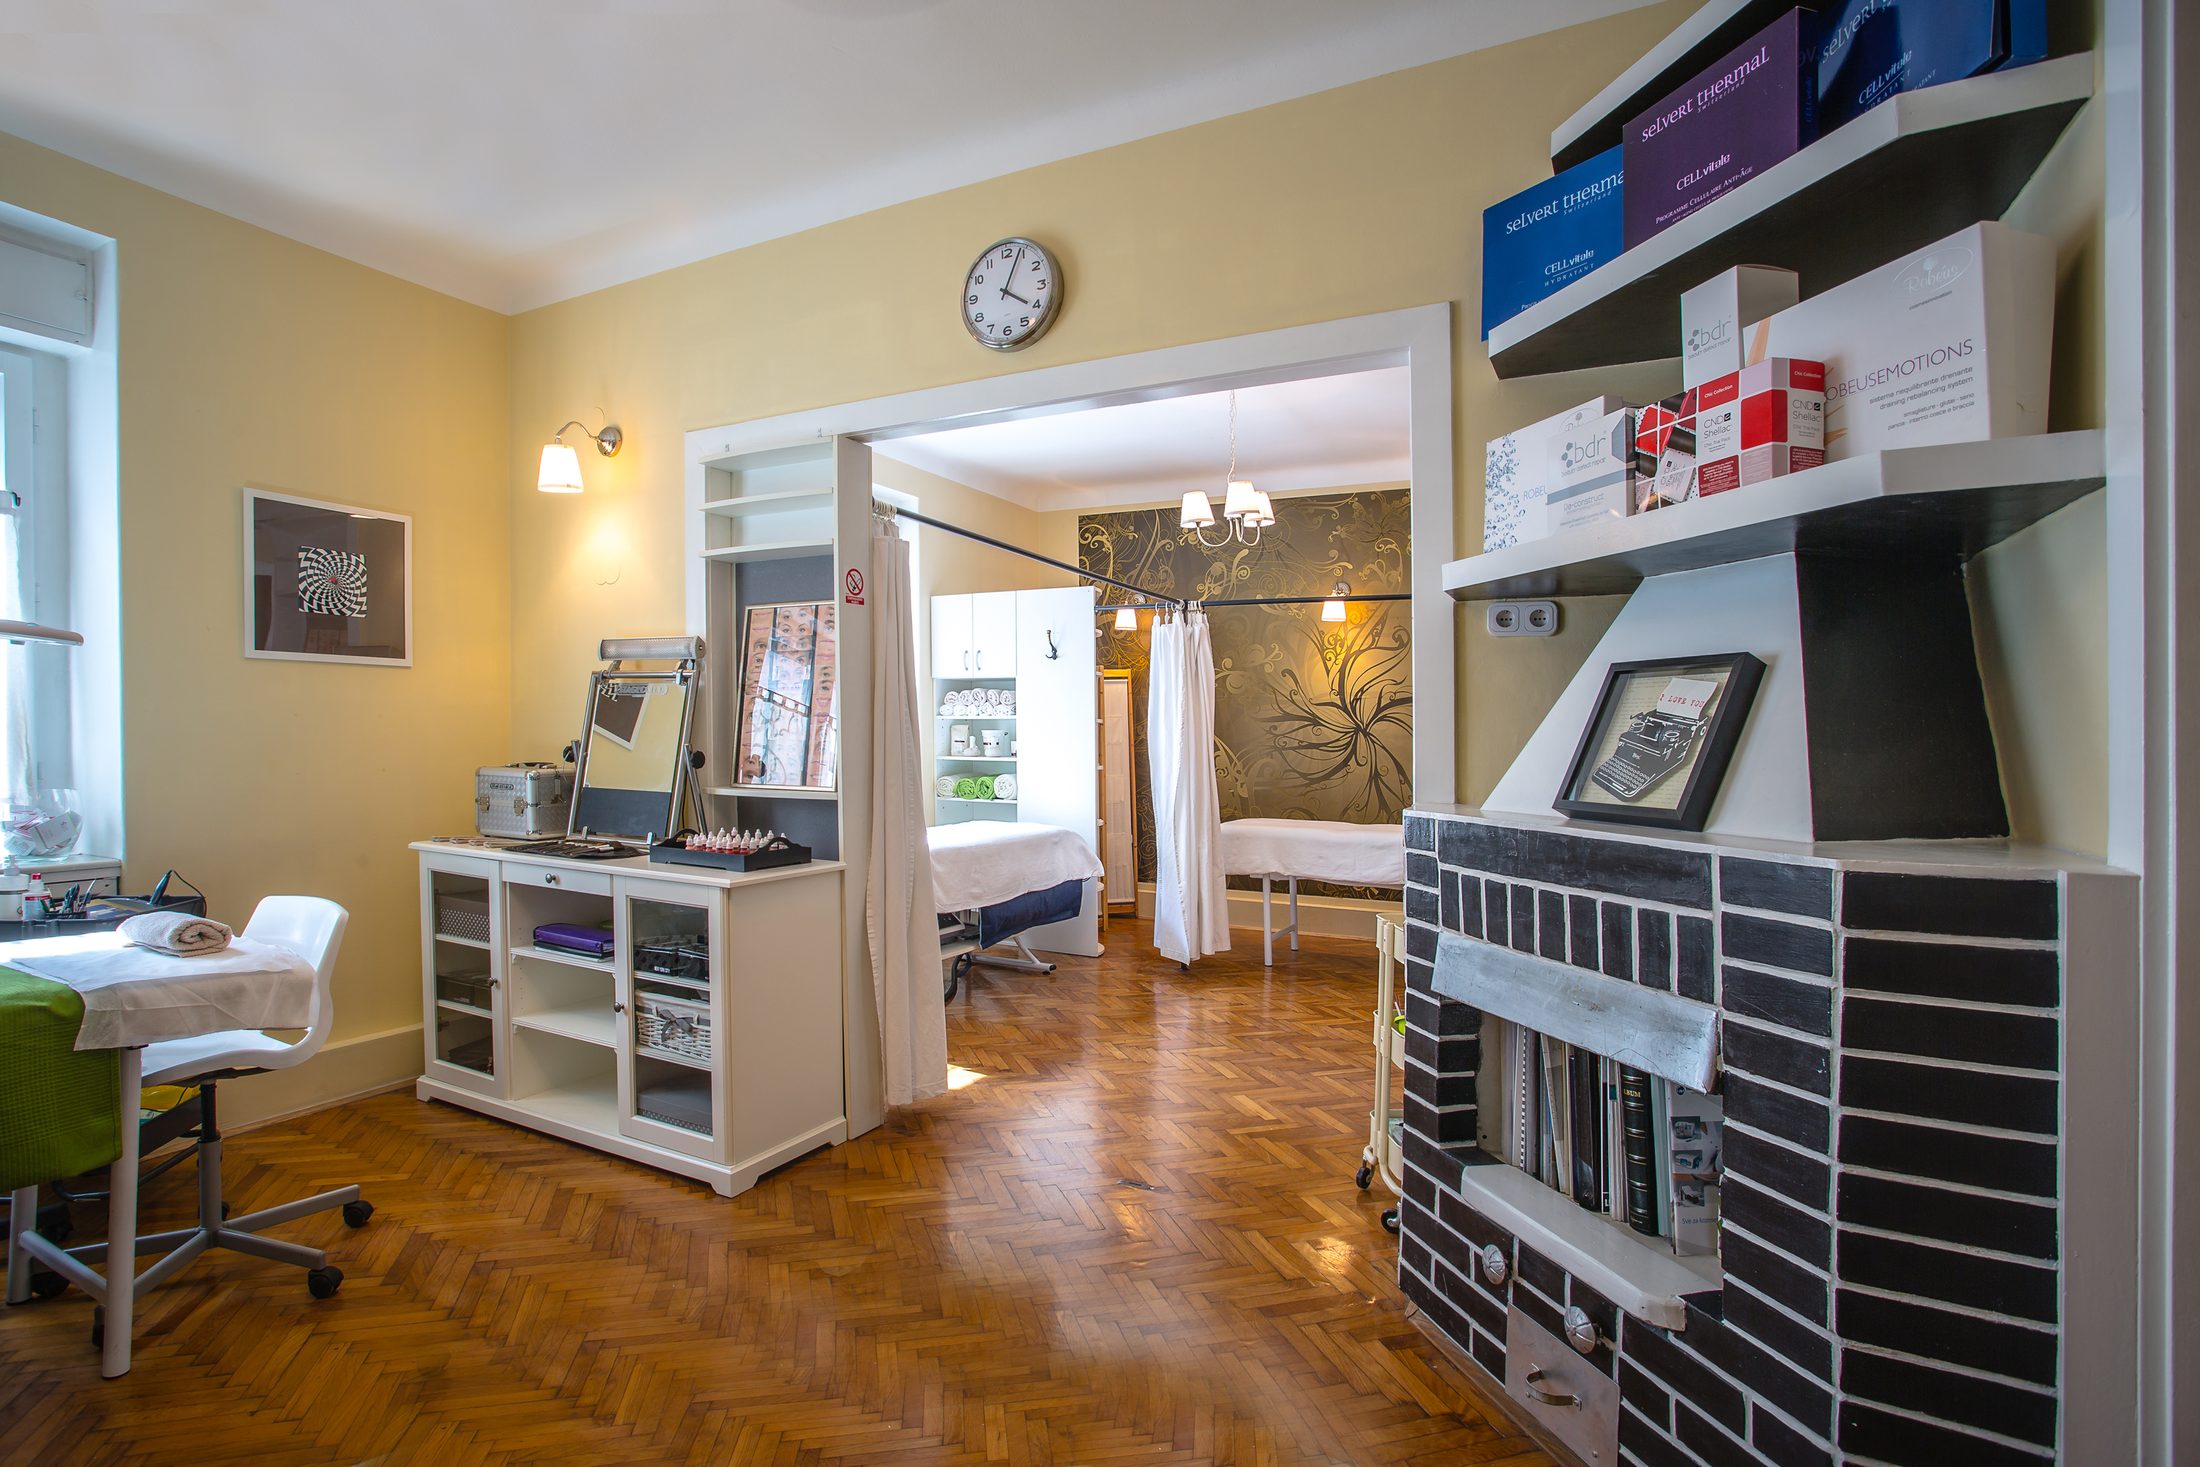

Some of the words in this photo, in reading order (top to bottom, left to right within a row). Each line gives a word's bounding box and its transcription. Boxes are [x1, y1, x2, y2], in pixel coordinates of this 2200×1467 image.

[1001, 249, 1012, 260] 12
[986, 259, 993, 270] 11
[1032, 261, 1040, 272] 2
[974, 275, 984, 286] 10
[1544, 263, 1595, 287] HYDRATANT
[1037, 279, 1046, 290] 3
[969, 295, 978, 304] 9
[1032, 299, 1041, 310] 4
[974, 313, 984, 322] 8
[1020, 317, 1030, 327] 5
[987, 324, 995, 334] 7
[1003, 326, 1012, 336] 6
[1700, 320, 1732, 346] bdr
[1825, 338, 1974, 401] OBEUSEMOTIONS
[1714, 384, 1732, 395] Collection
[1880, 396, 1906, 410] draining
[1906, 384, 1946, 403] rebalancing
[1947, 376, 1974, 390] system
[1792, 411, 1820, 422] Shellac
[1704, 424, 1731, 438] Shellac
[1574, 434, 1606, 464] bdr
[1668, 696, 1687, 704] LOVE
[1690, 700, 1704, 708] YOU
[1624, 1088, 1642, 1098] LBUM
